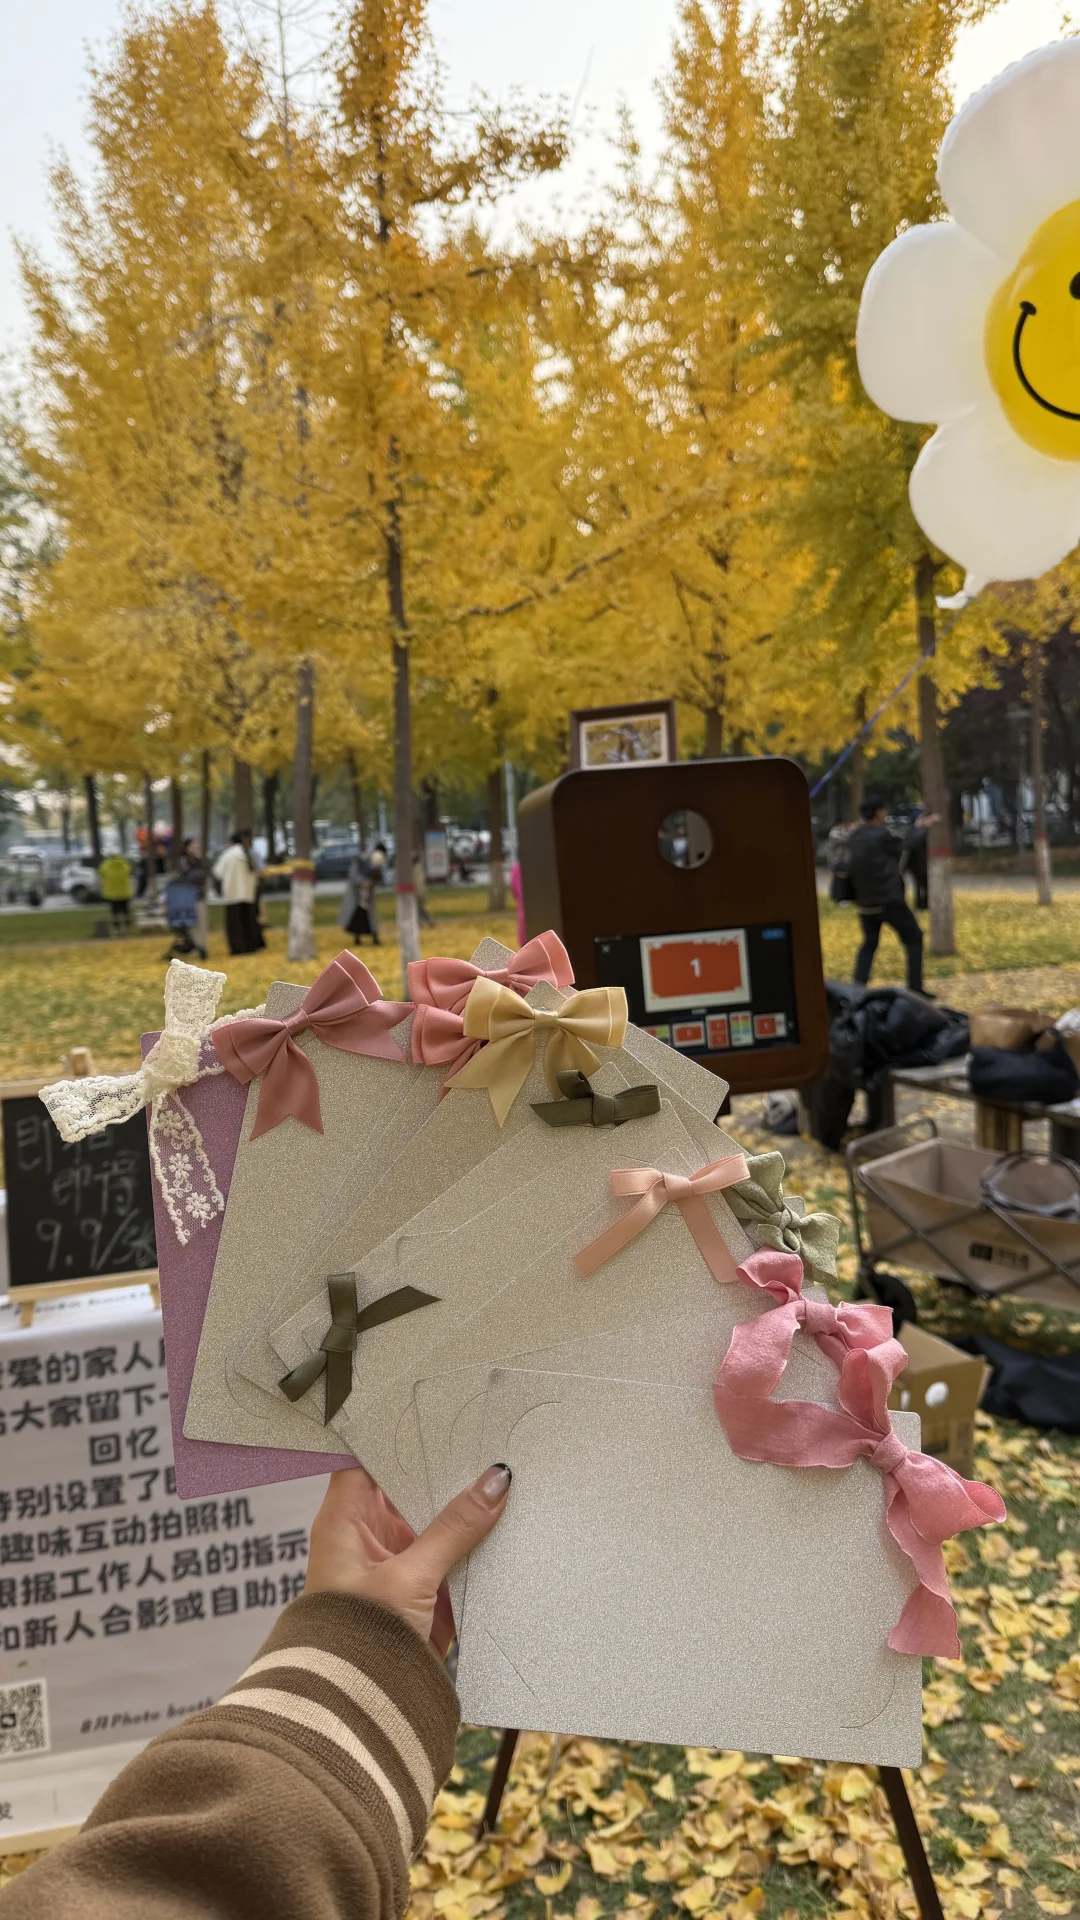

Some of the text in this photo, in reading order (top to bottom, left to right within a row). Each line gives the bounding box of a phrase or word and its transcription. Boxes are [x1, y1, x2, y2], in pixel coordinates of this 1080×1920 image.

[690, 957, 703, 978] 1
[0, 1338, 166, 1389] 爱的家人
[0, 1383, 169, 1436] 大家留下
[89, 1426, 159, 1466] 回忆
[0, 1497, 255, 1564] 趣味互动拍照机
